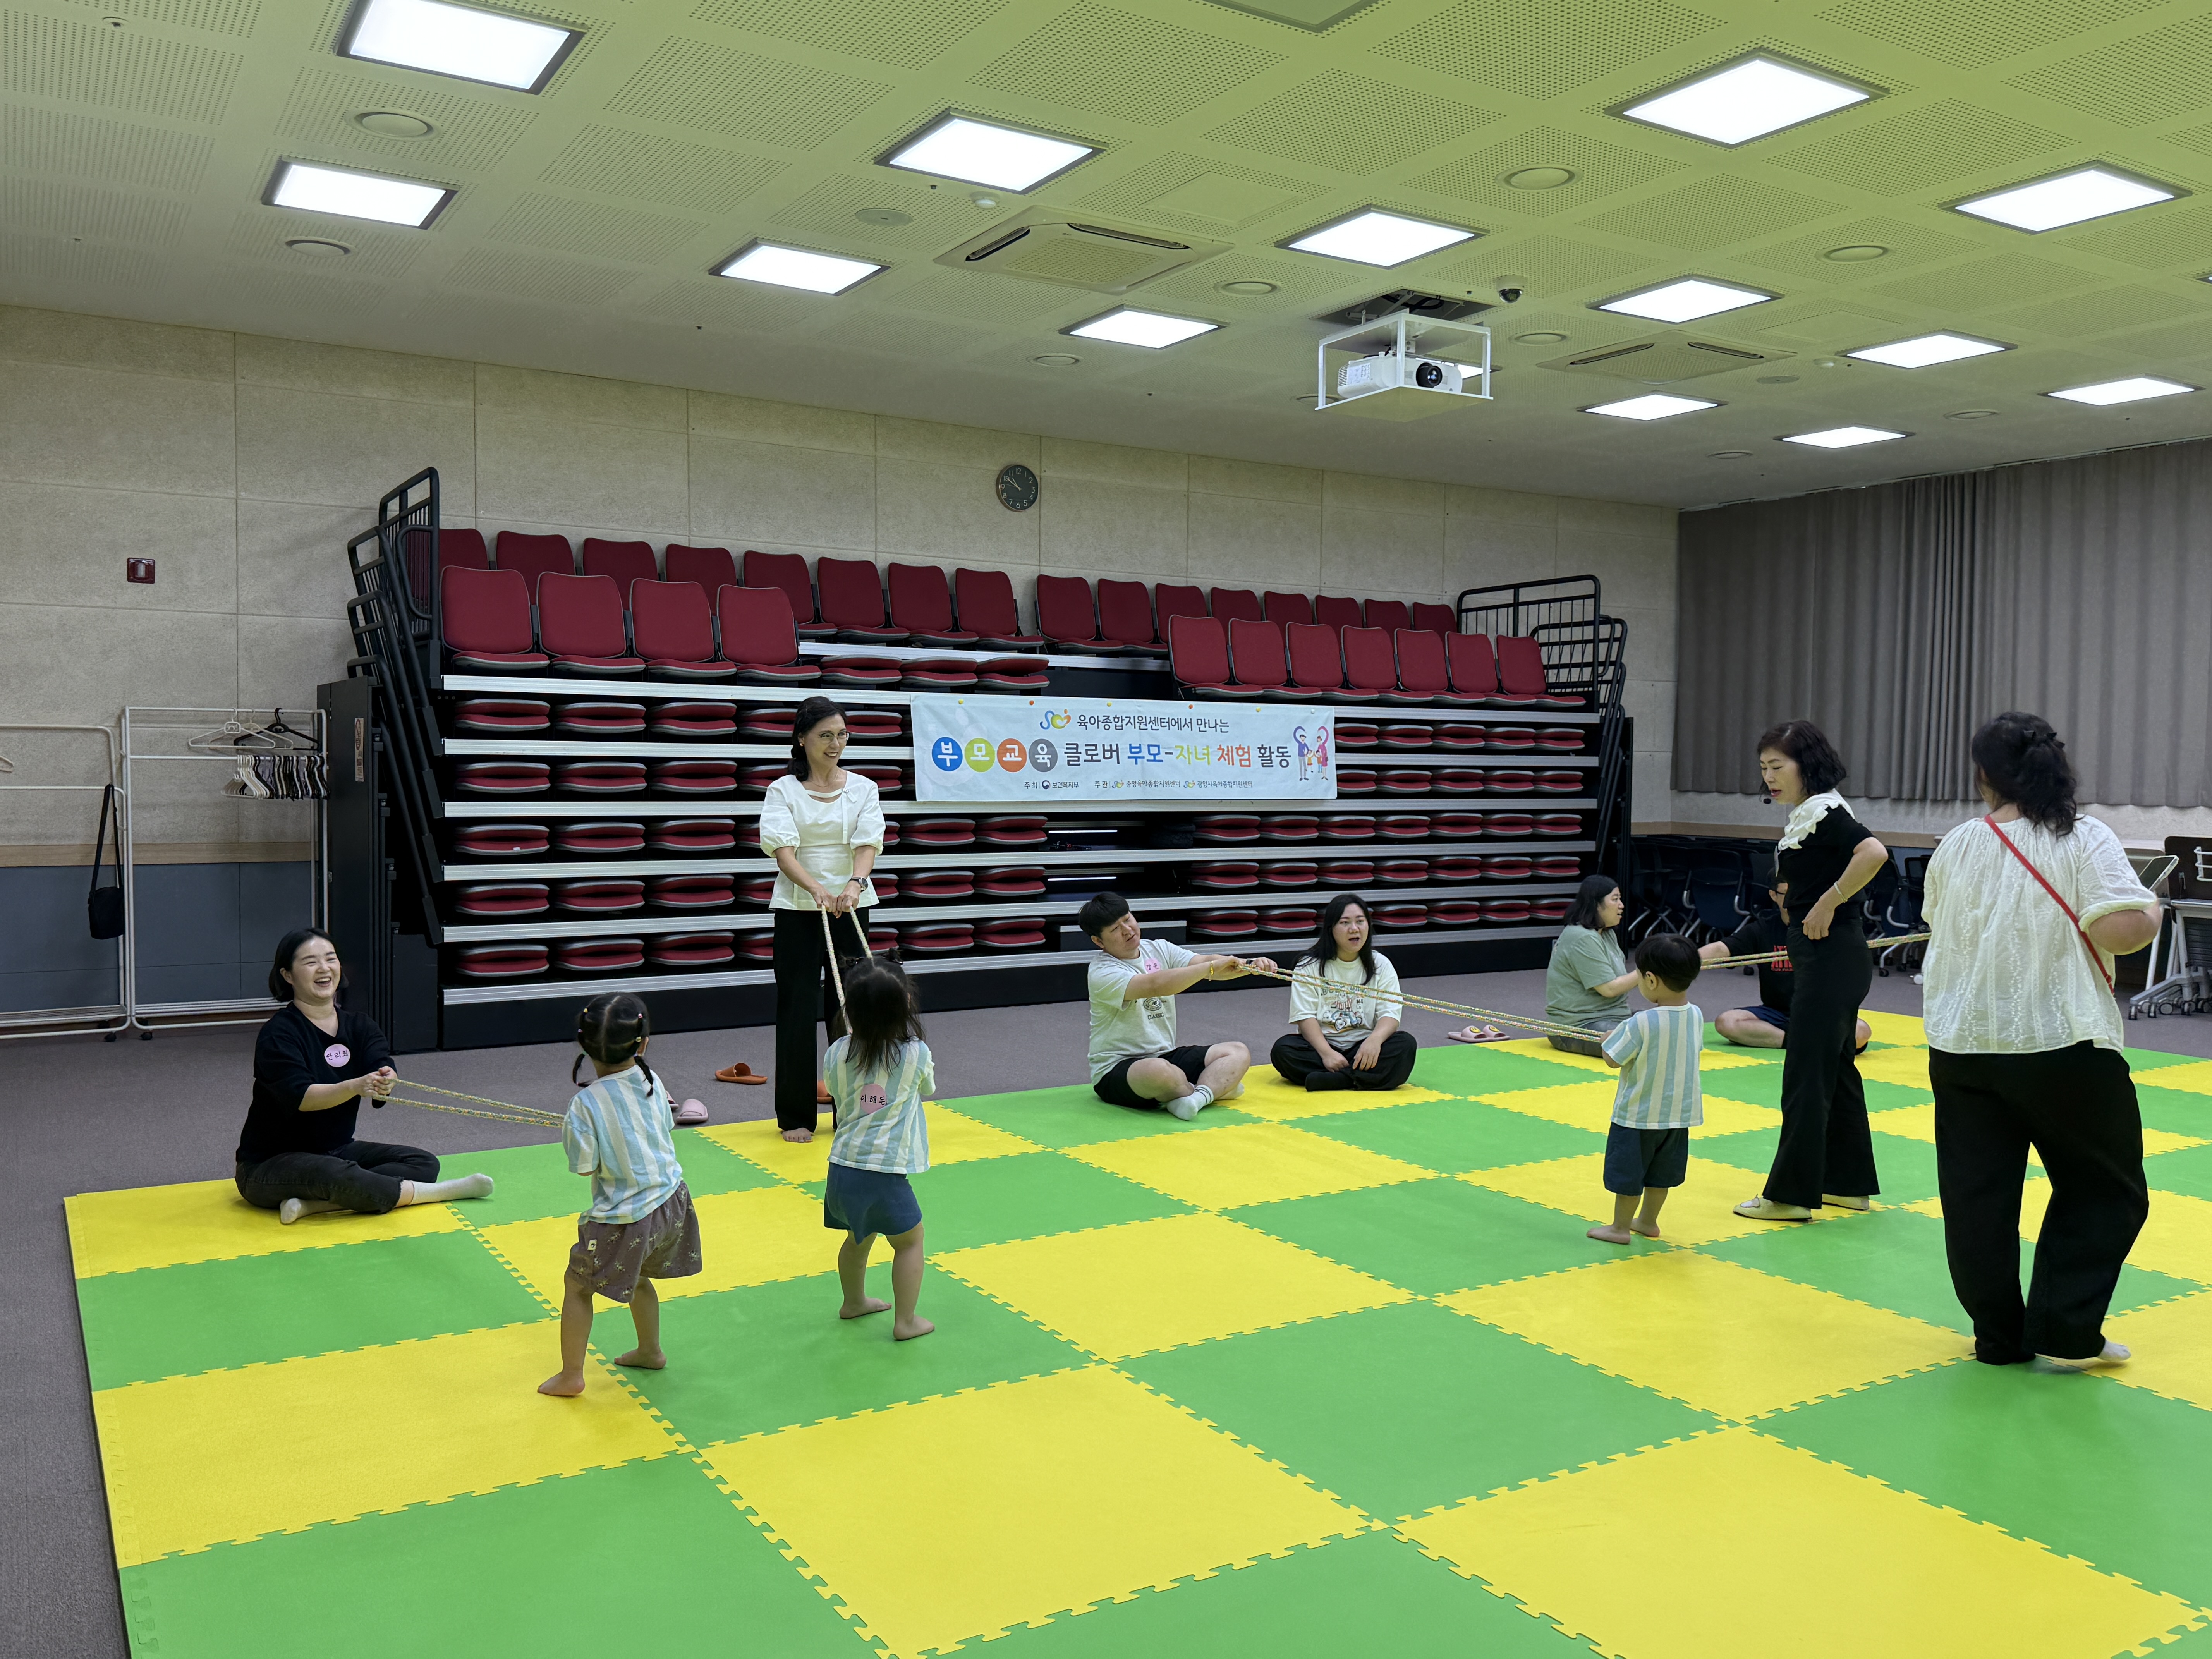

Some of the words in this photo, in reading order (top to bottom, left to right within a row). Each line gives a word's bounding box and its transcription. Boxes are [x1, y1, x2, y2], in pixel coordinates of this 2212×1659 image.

[1077, 714, 1193, 731] 육아종합지원센터에서
[1196, 718, 1230, 733] 만나는
[937, 741, 1052, 768] 부모교육
[1064, 742, 1120, 766] 클로버
[1127, 743, 1211, 766] 부모-자녀
[1217, 744, 1252, 768] 체험
[1257, 744, 1291, 768] 활동
